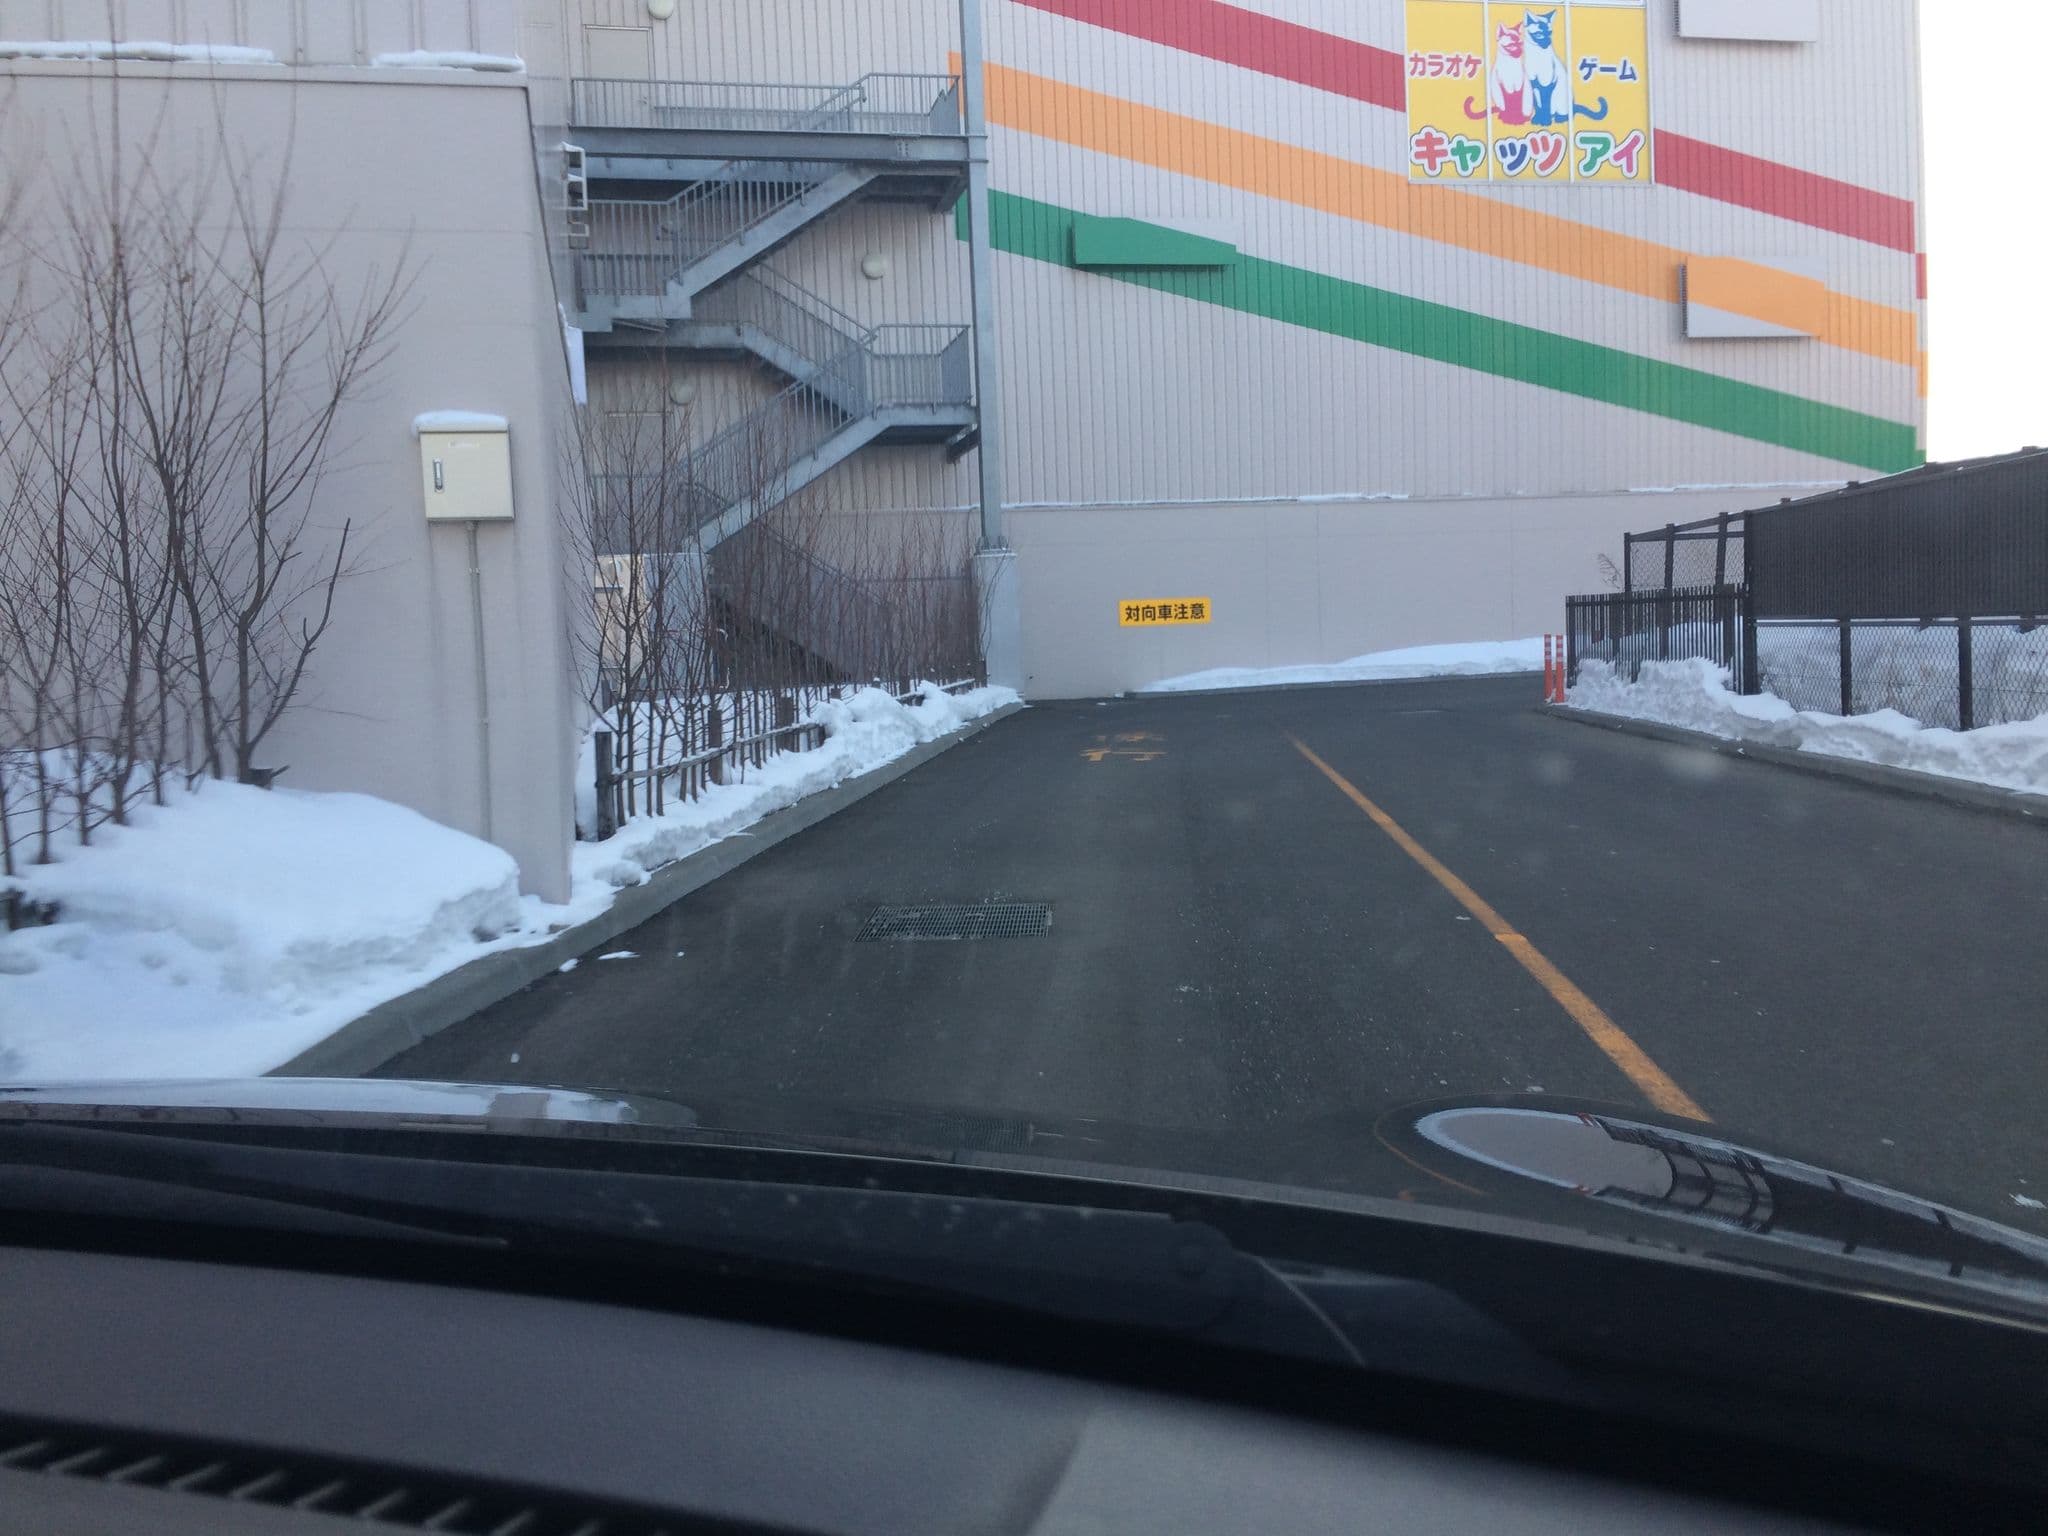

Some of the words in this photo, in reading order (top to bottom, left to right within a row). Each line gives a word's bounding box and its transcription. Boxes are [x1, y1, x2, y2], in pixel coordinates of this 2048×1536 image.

[1408, 52, 1482, 79] カラオケ
[1578, 57, 1638, 81] ゲーム
[1125, 603, 1205, 622] 対向車注意
